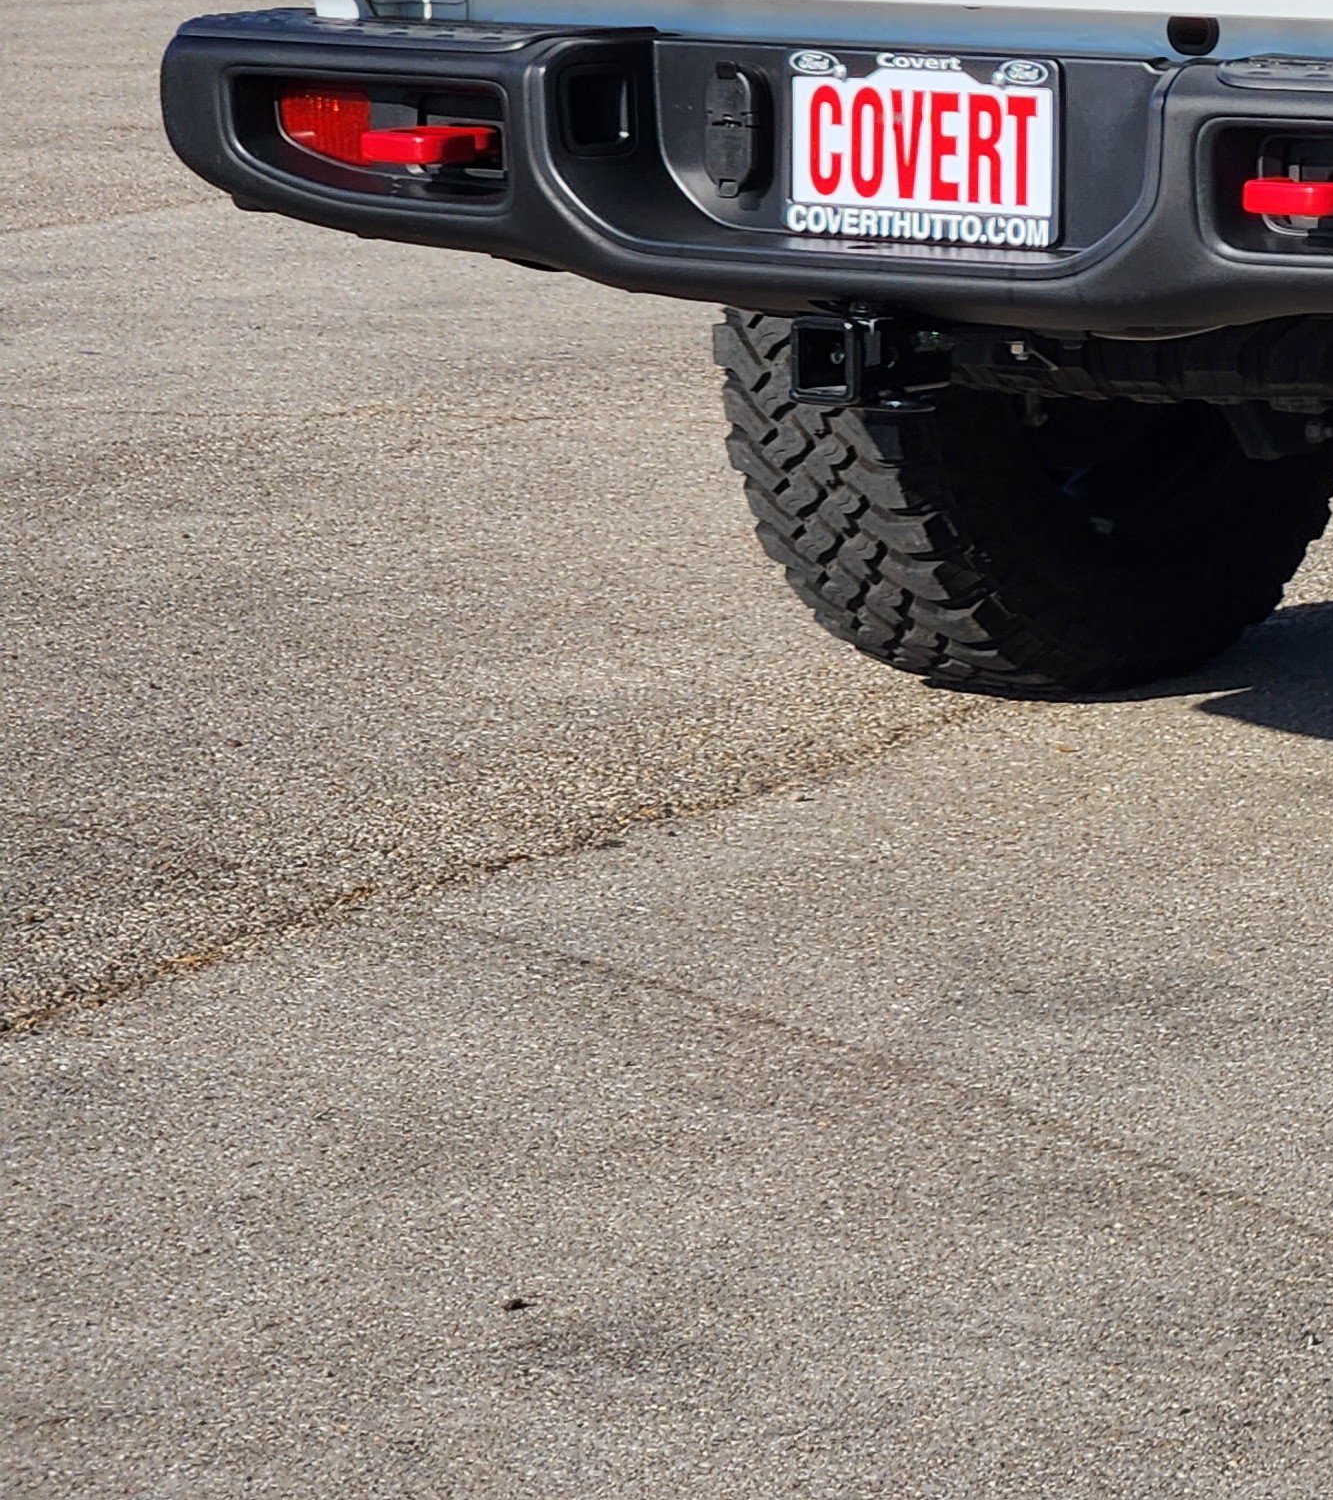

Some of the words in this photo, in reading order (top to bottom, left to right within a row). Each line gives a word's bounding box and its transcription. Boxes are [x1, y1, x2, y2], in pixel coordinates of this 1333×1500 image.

[876, 52, 962, 71] Covert
[809, 85, 1039, 206] COVERT
[787, 206, 1050, 247] COVERTHUTTO.COM
